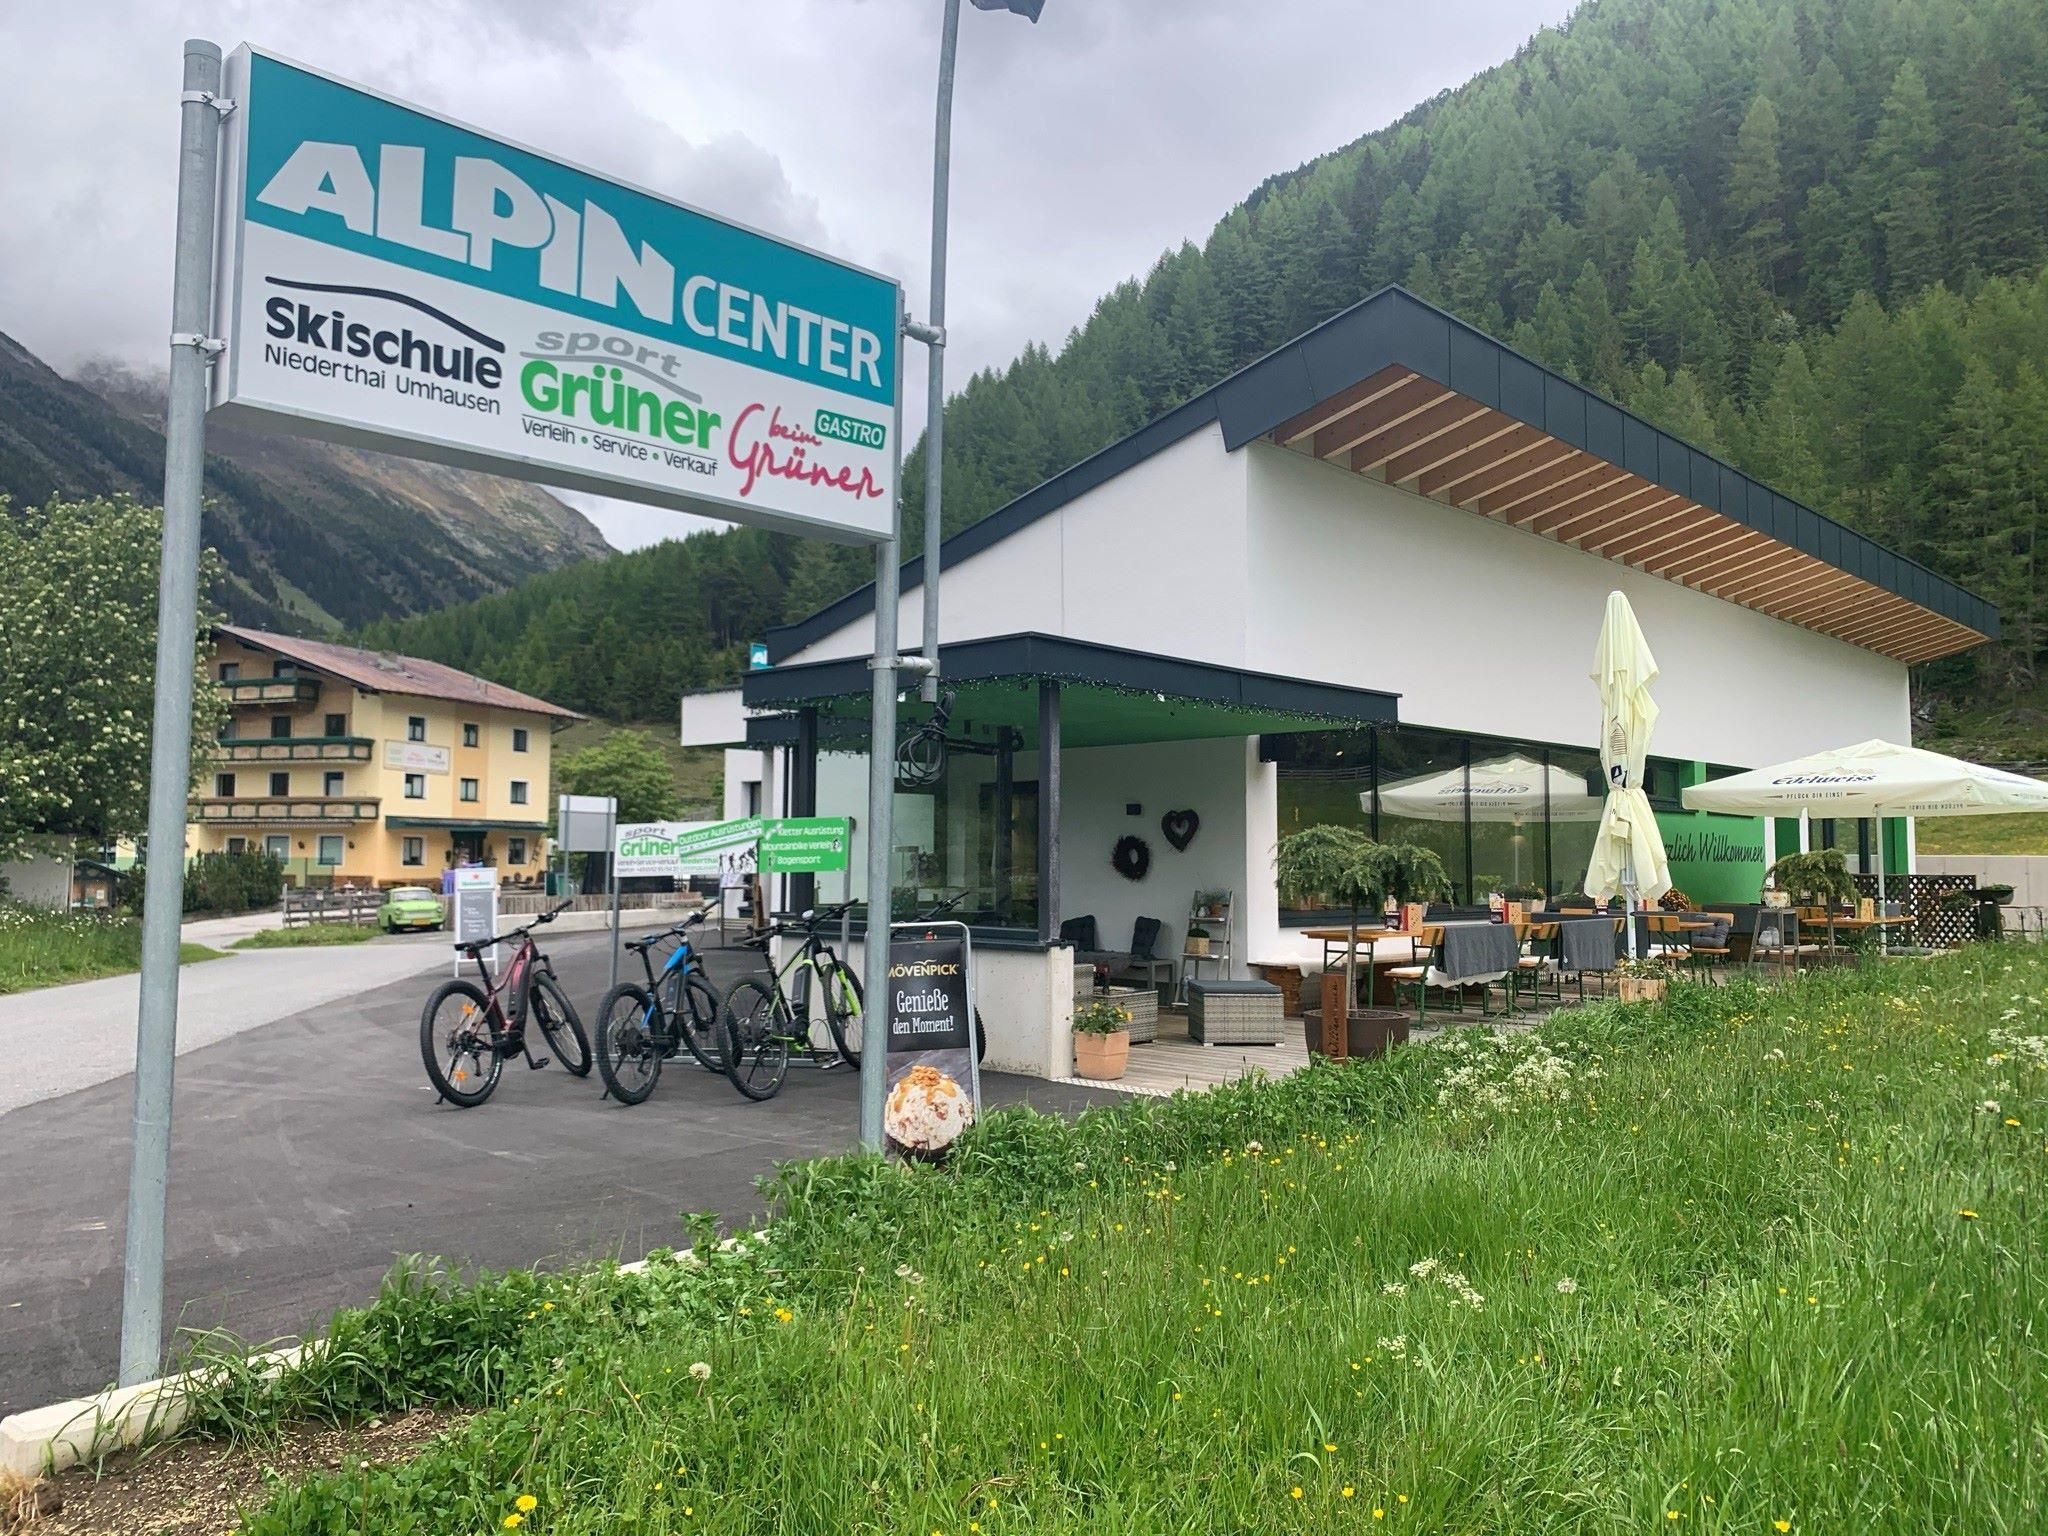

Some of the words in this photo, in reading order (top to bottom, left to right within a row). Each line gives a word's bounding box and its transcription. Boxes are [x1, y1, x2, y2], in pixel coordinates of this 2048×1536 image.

[256, 141, 675, 325] ALPIN
[681, 275, 882, 388] CENTER
[265, 297, 503, 389] Skischule
[535, 330, 682, 378] sport
[265, 343, 386, 389] Niederthai
[395, 374, 501, 415] Umhausen
[519, 358, 721, 449] Grüner
[522, 418, 576, 445] Verleih
[592, 433, 648, 462] Service
[664, 450, 718, 477] Verkauf
[768, 406, 822, 447] beim
[817, 413, 884, 447] GASTRO
[728, 403, 884, 499] Grüner
[620, 837, 679, 857] Grüner
[625, 826, 667, 838] sport
[1700, 832, 1766, 863] Willkommen
[896, 988, 949, 1013] Genieße
[893, 1018, 911, 1034] den
[912, 1015, 954, 1034] Moment!
